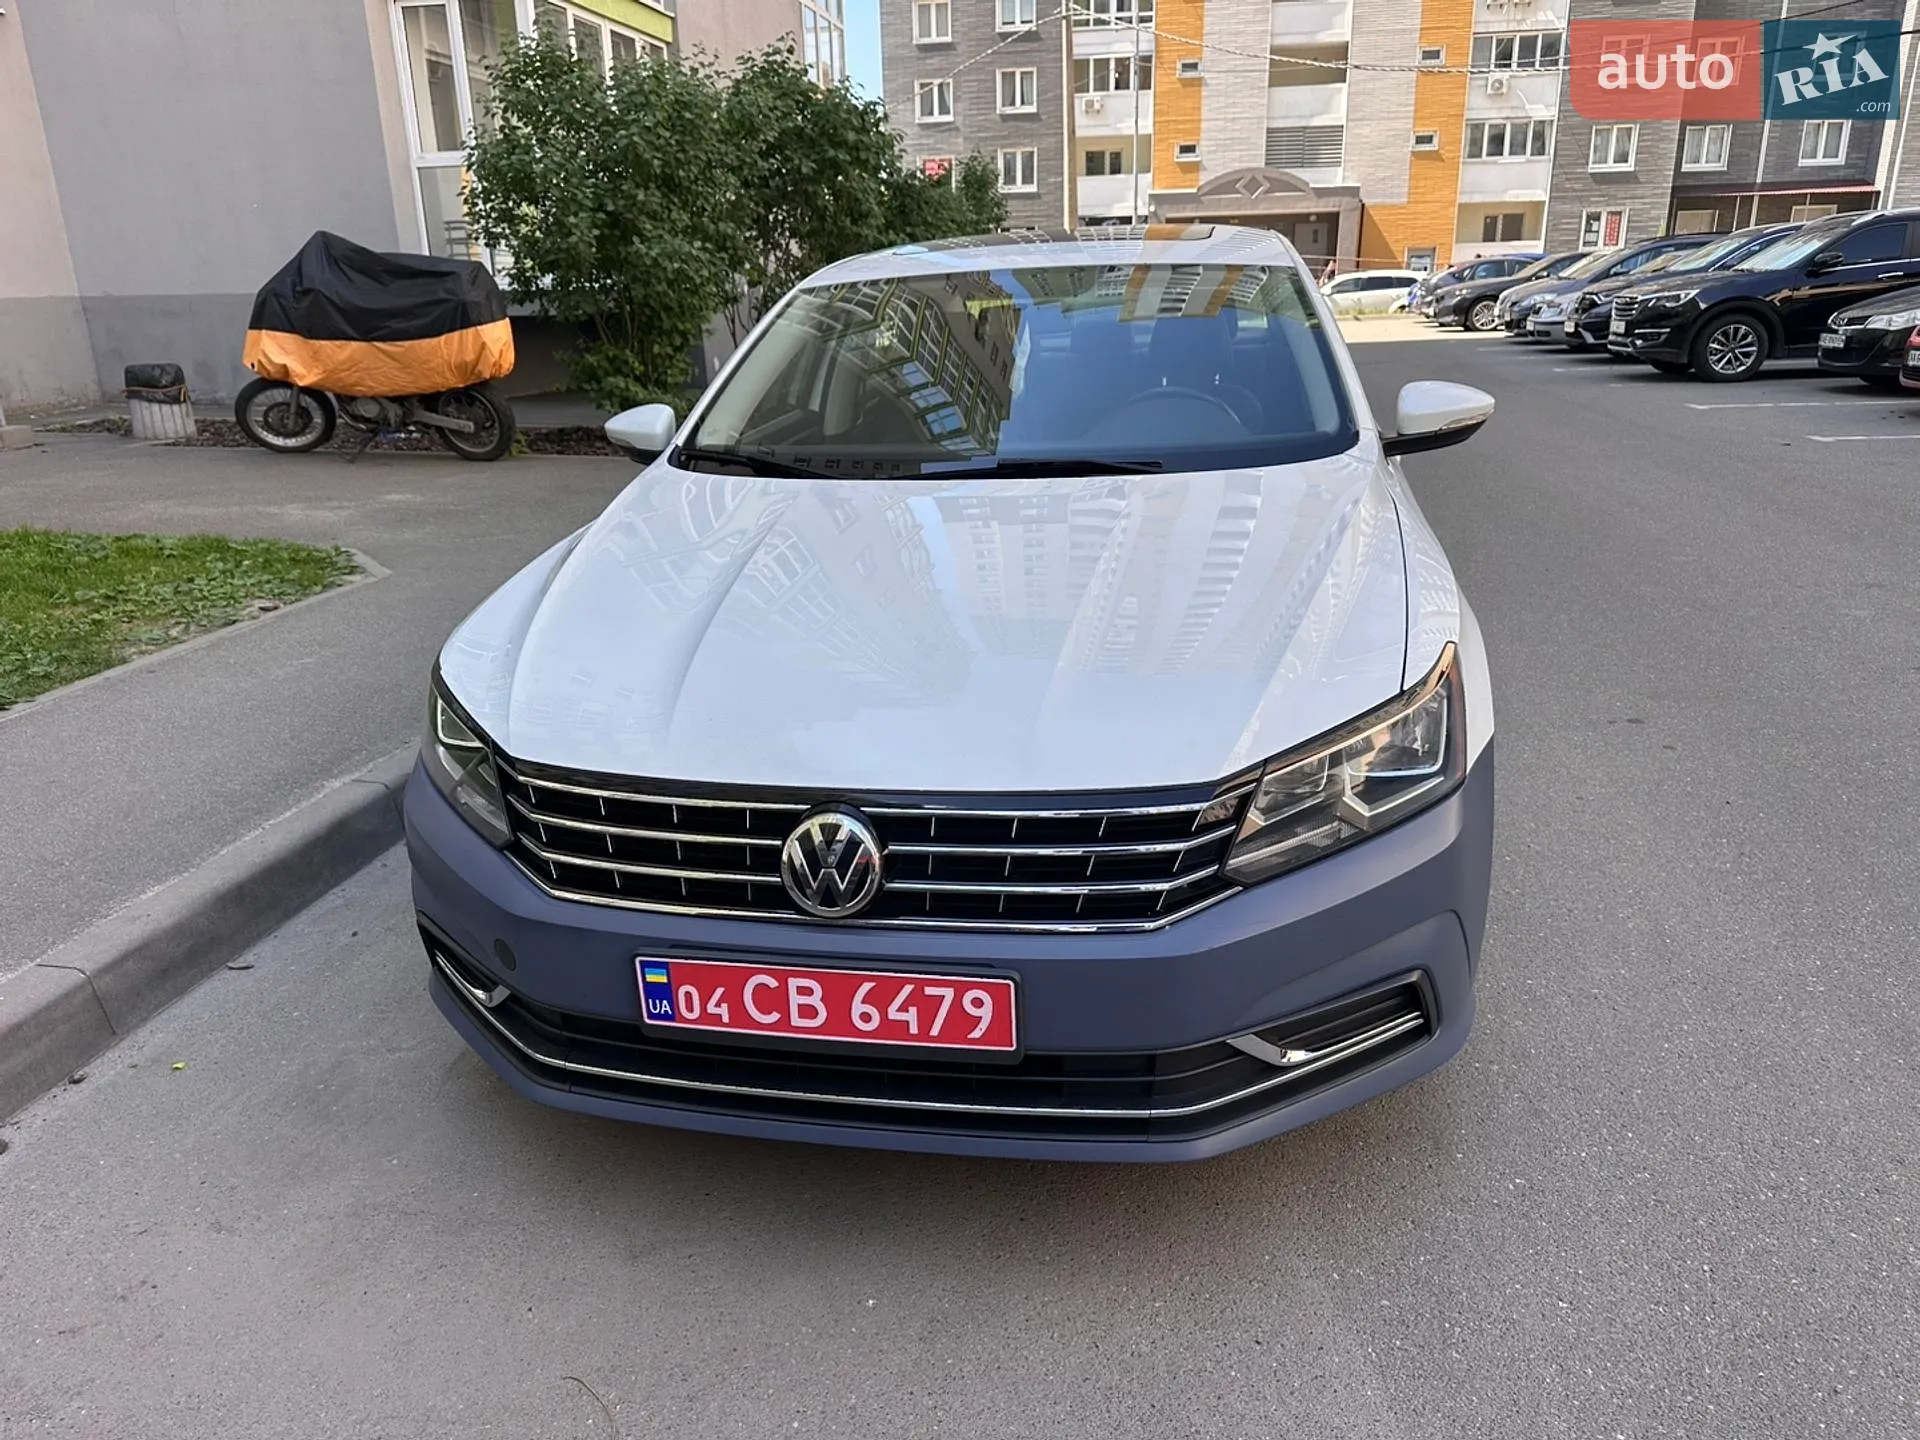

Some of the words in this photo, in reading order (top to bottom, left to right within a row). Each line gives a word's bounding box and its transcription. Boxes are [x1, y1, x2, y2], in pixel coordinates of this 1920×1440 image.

[648, 998, 672, 1016] UA
[677, 985, 730, 1023] 04
[743, 974, 828, 1028] CB
[851, 981, 994, 1039] 6479
